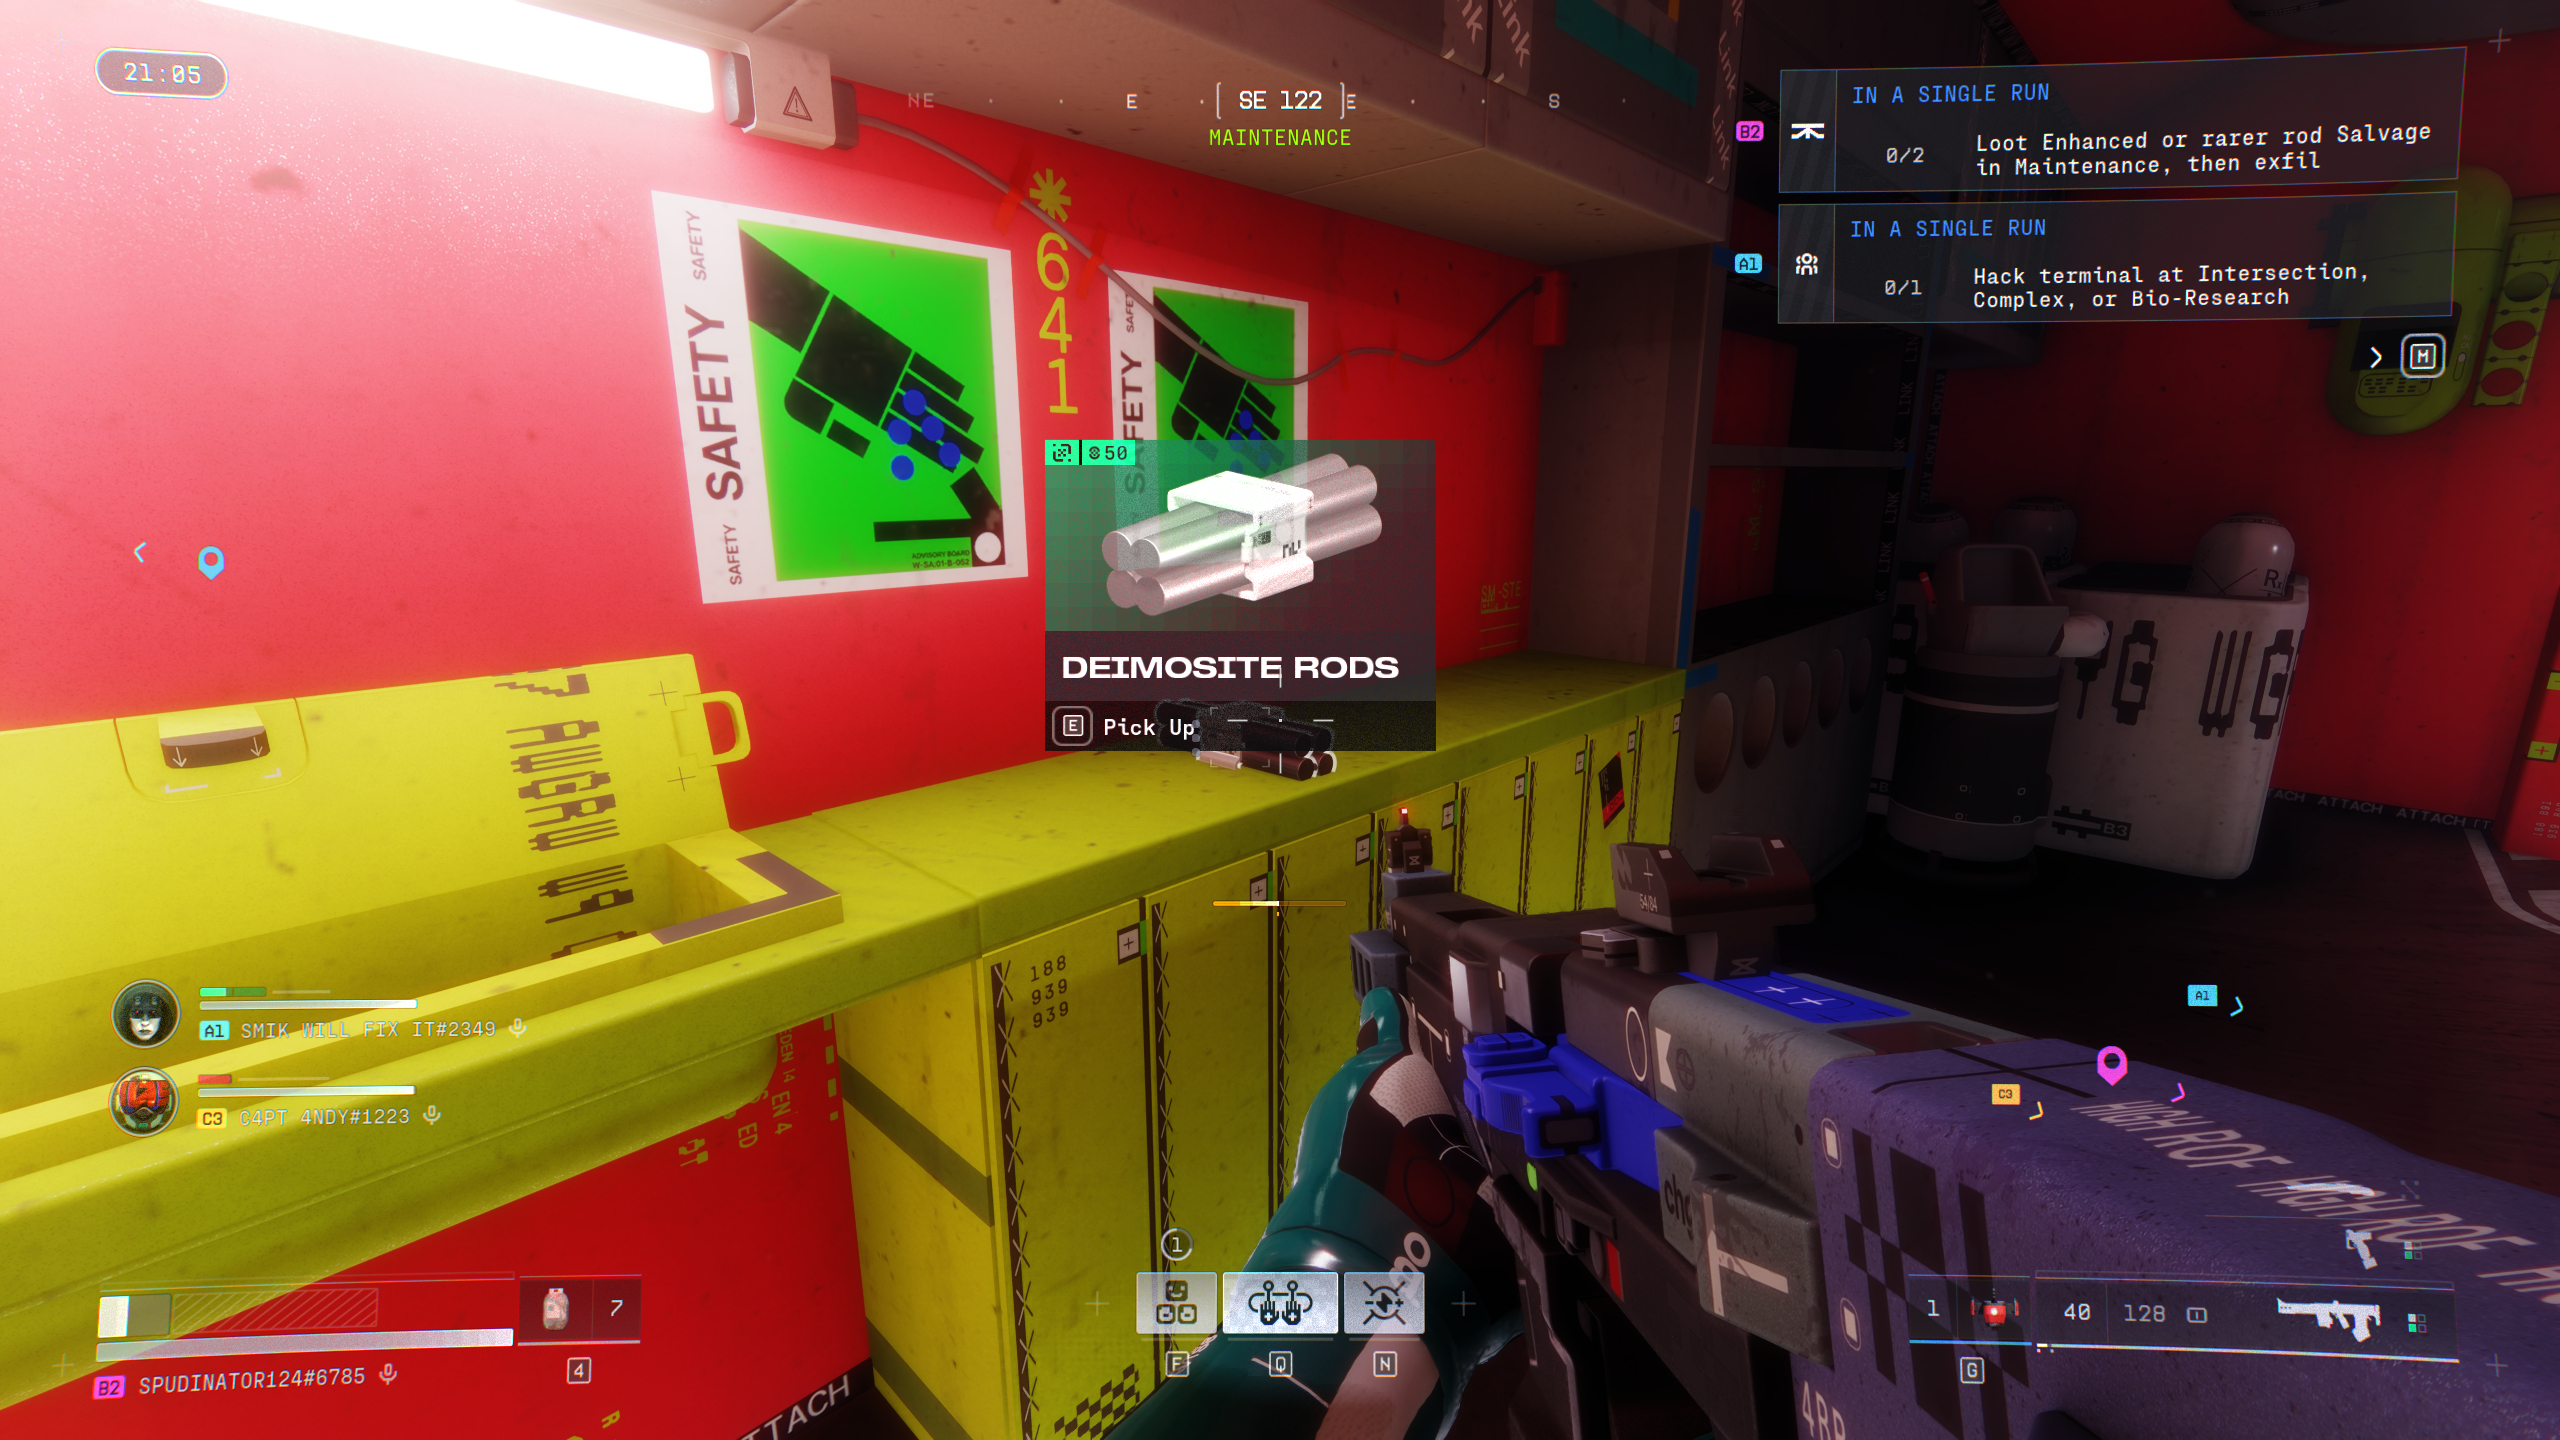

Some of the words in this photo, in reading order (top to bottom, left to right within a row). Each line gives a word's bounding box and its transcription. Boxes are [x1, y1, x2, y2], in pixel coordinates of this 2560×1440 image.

[1500, 0, 1530, 69] ink
[685, 210, 708, 281] SAFETY
[1905, 336, 1920, 363] LIN
[684, 304, 744, 501] SAFETY
[1897, 381, 1914, 416] LINK
[1918, 471, 1933, 506] ATTAC
[1884, 491, 1900, 525] LINK
[722, 524, 743, 585] SAFETY
[1877, 541, 1893, 574] LINK
[2268, 787, 2306, 803] TACH
[2317, 795, 2384, 816] ATTACH
[2396, 807, 2467, 828] ATTACH
[2103, 821, 2128, 837] B3
[1030, 955, 1067, 983] 188
[1031, 978, 1068, 1006] 939
[1032, 1001, 1069, 1029] 939
[2070, 1100, 2215, 1132] HIGH
[2142, 1128, 2294, 1169] ROF
[2340, 1212, 2538, 1251] ROF
